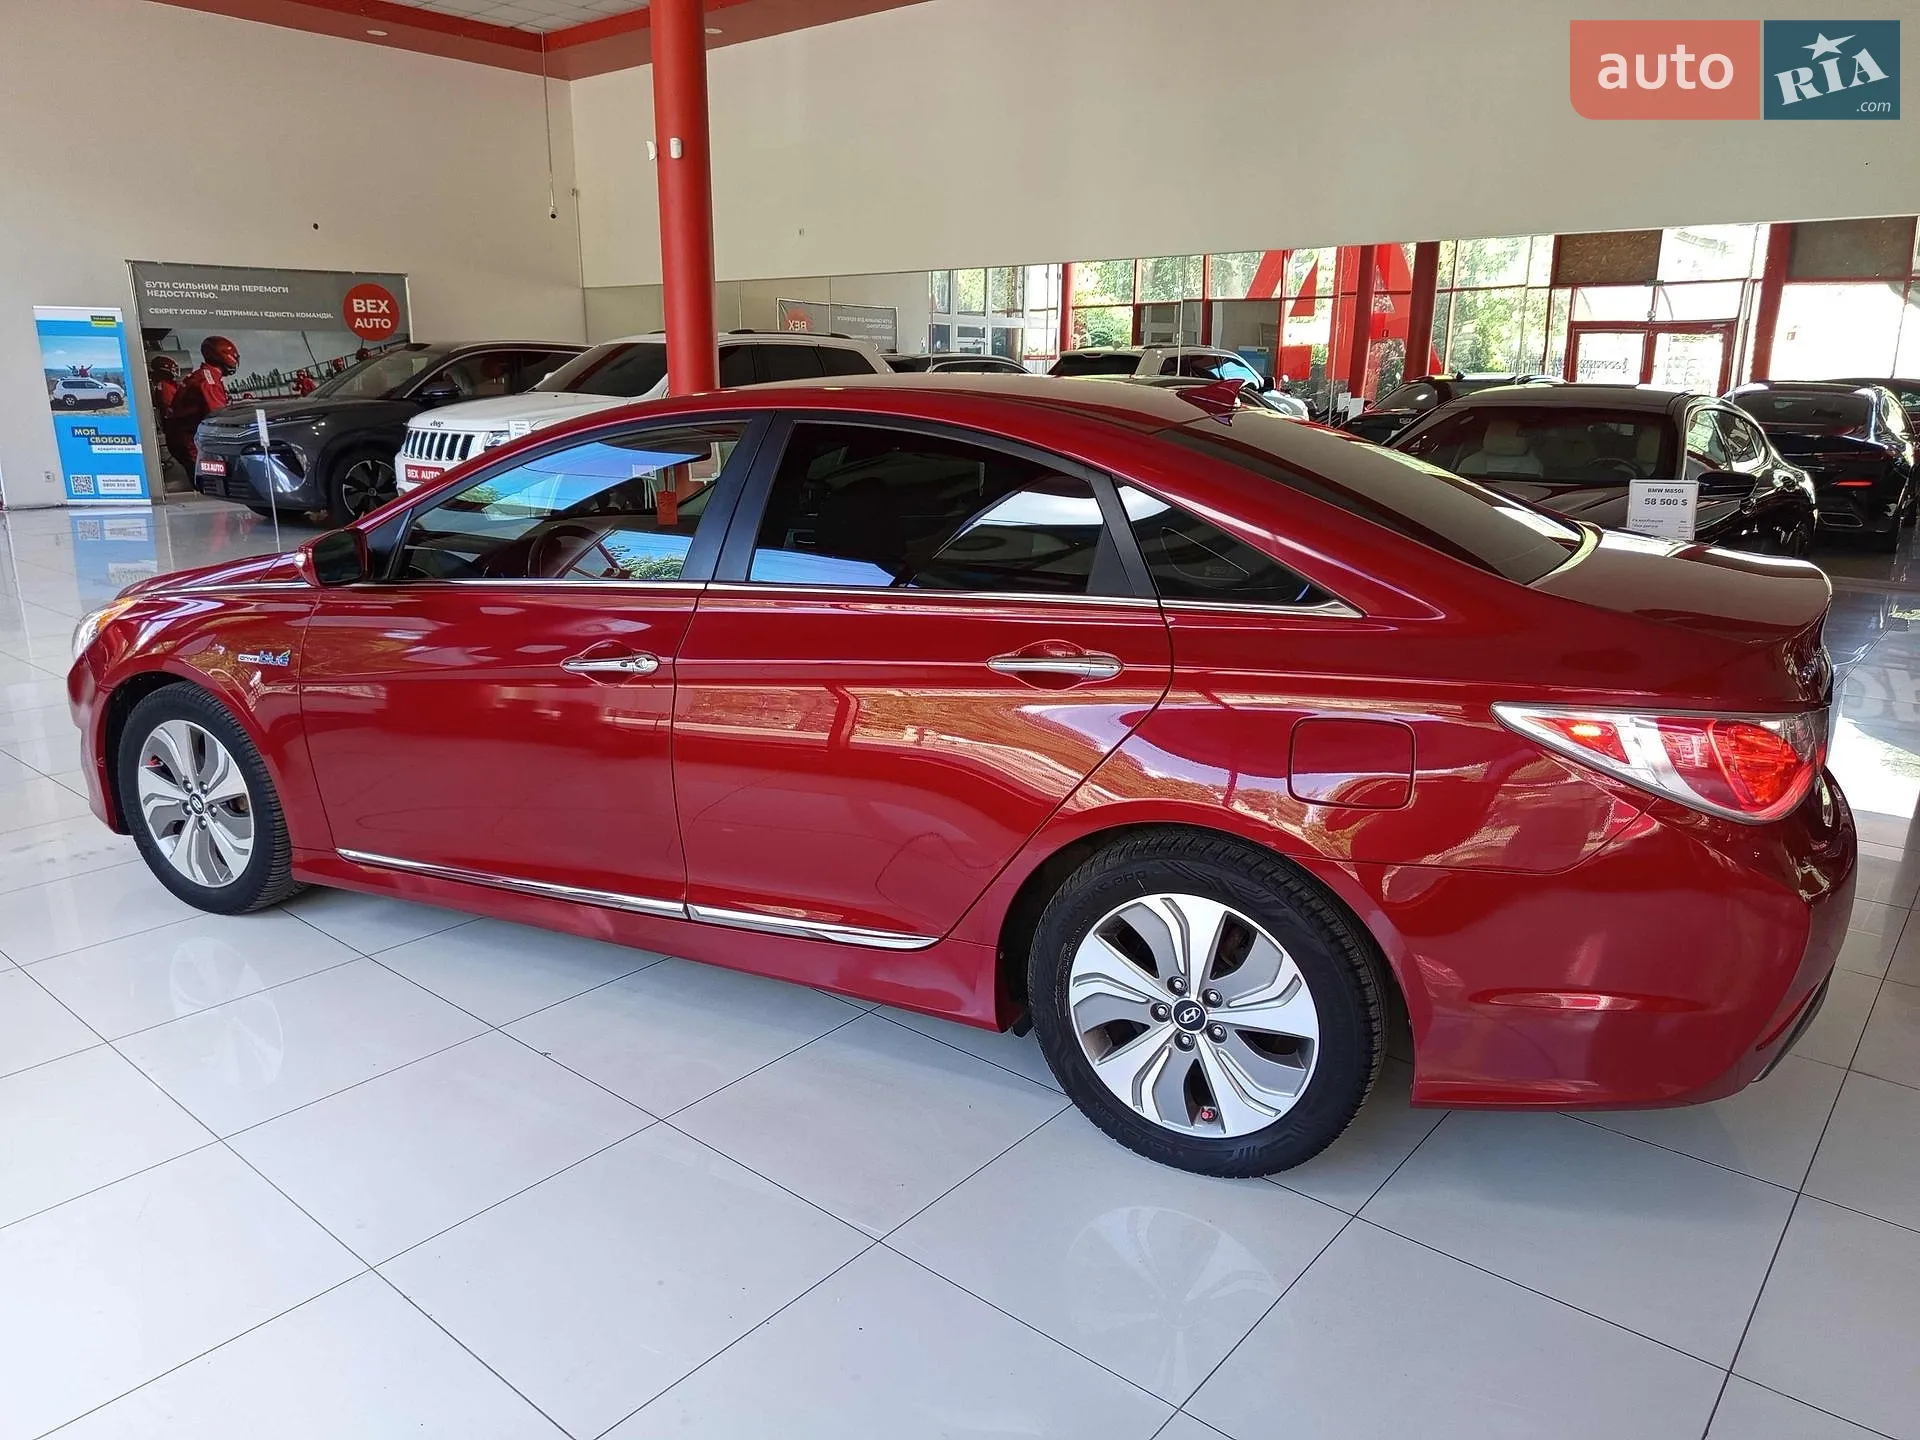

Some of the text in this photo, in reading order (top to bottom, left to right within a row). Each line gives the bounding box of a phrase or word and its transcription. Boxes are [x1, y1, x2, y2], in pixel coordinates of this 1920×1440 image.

[172, 282, 219, 290] СИЛЬНИМ
[241, 285, 289, 293] ПЕРЕМОГИ
[146, 290, 218, 299] НЕДОСТАТНЬО.
[352, 298, 391, 314] BEX
[149, 307, 178, 315] СЕКРЕТ
[354, 317, 392, 329] AUTO
[74, 428, 97, 436] МОЯ
[90, 436, 135, 445] СВОБОДА
[1644, 498, 1657, 506] 58
[1659, 498, 1678, 506] 500
